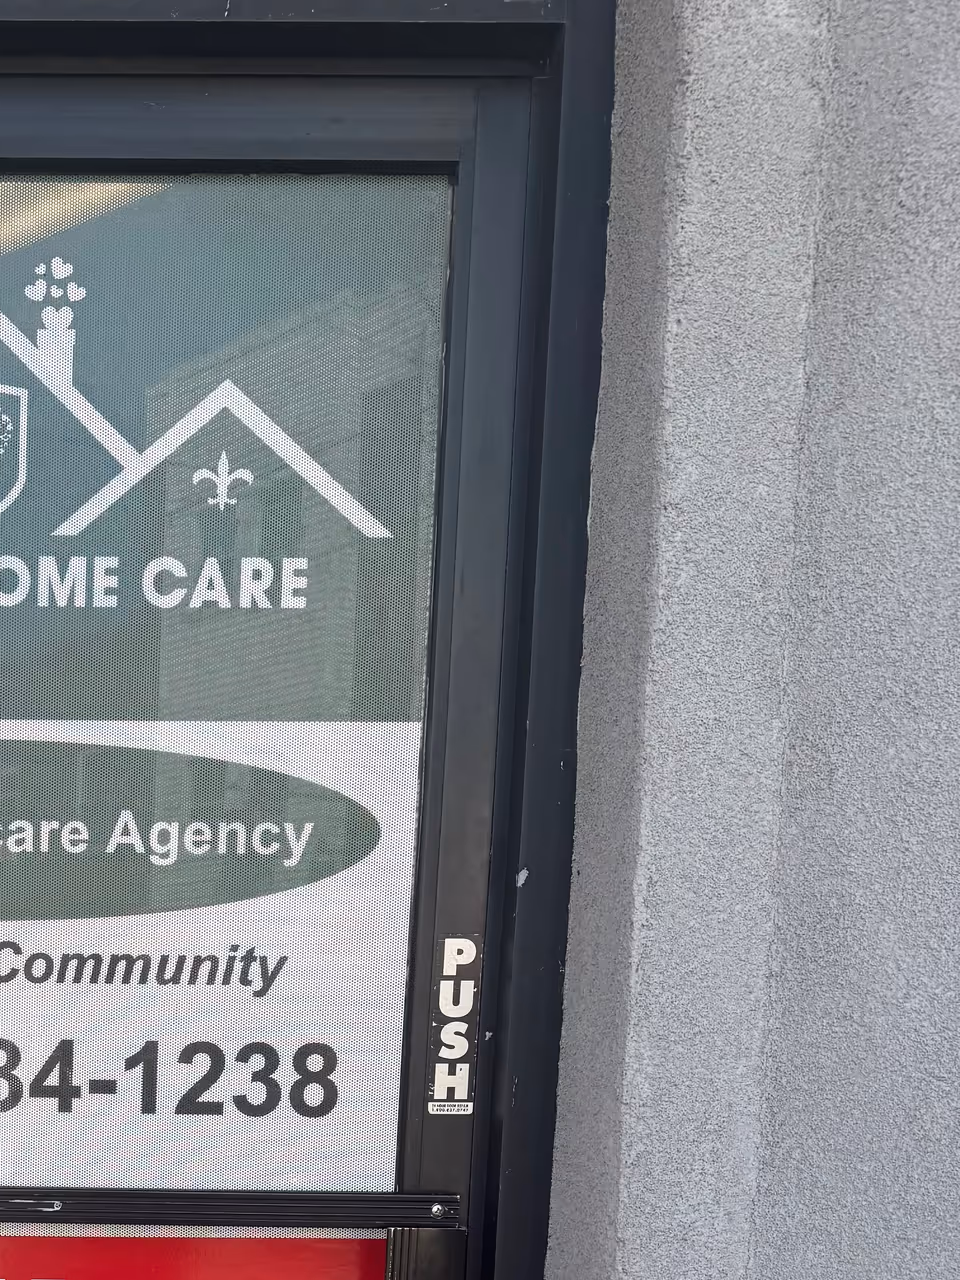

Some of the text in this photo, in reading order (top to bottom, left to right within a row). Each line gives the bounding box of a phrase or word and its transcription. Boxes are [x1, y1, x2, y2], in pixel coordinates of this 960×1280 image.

[143, 556, 308, 609] CARE
[106, 810, 314, 867] Agency
[434, 938, 476, 1100] PUSH
